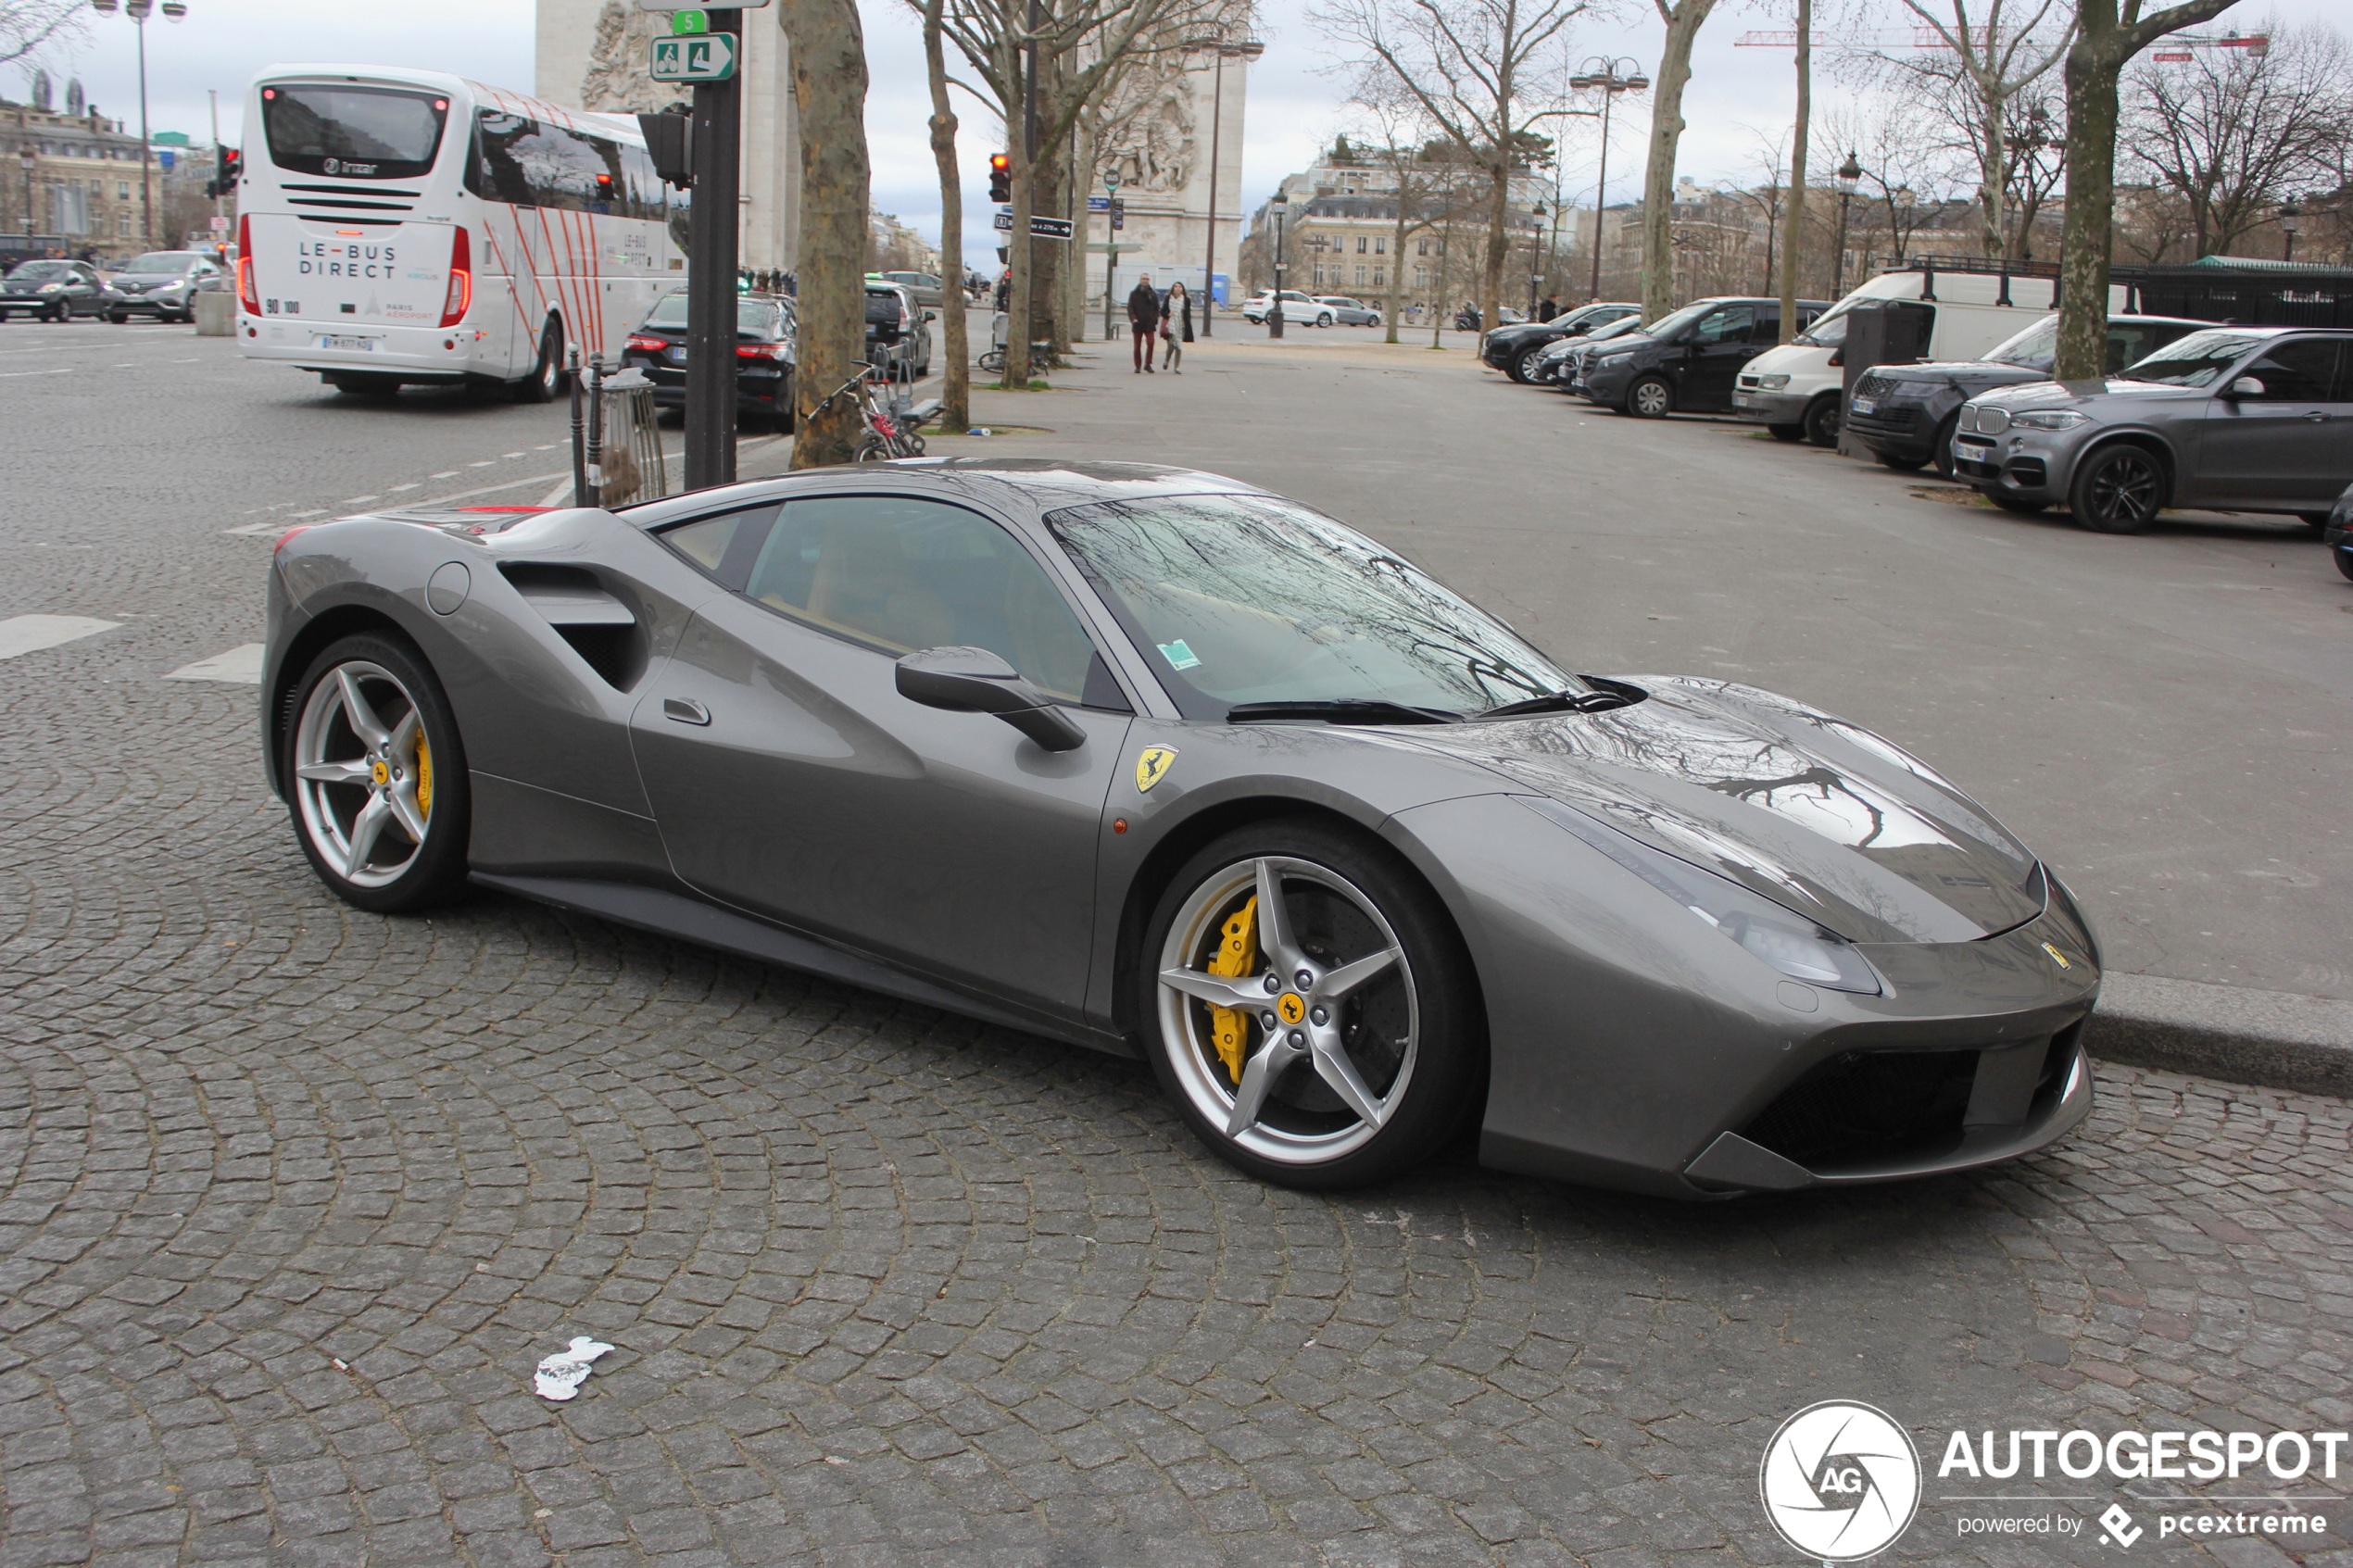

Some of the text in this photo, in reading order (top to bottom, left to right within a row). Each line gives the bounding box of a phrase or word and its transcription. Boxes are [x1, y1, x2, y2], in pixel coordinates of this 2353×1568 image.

[685, 14, 693, 31] 5
[299, 260, 396, 279] DIRECT
[266, 298, 300, 314] 90 100
[385, 303, 413, 312] PARIS
